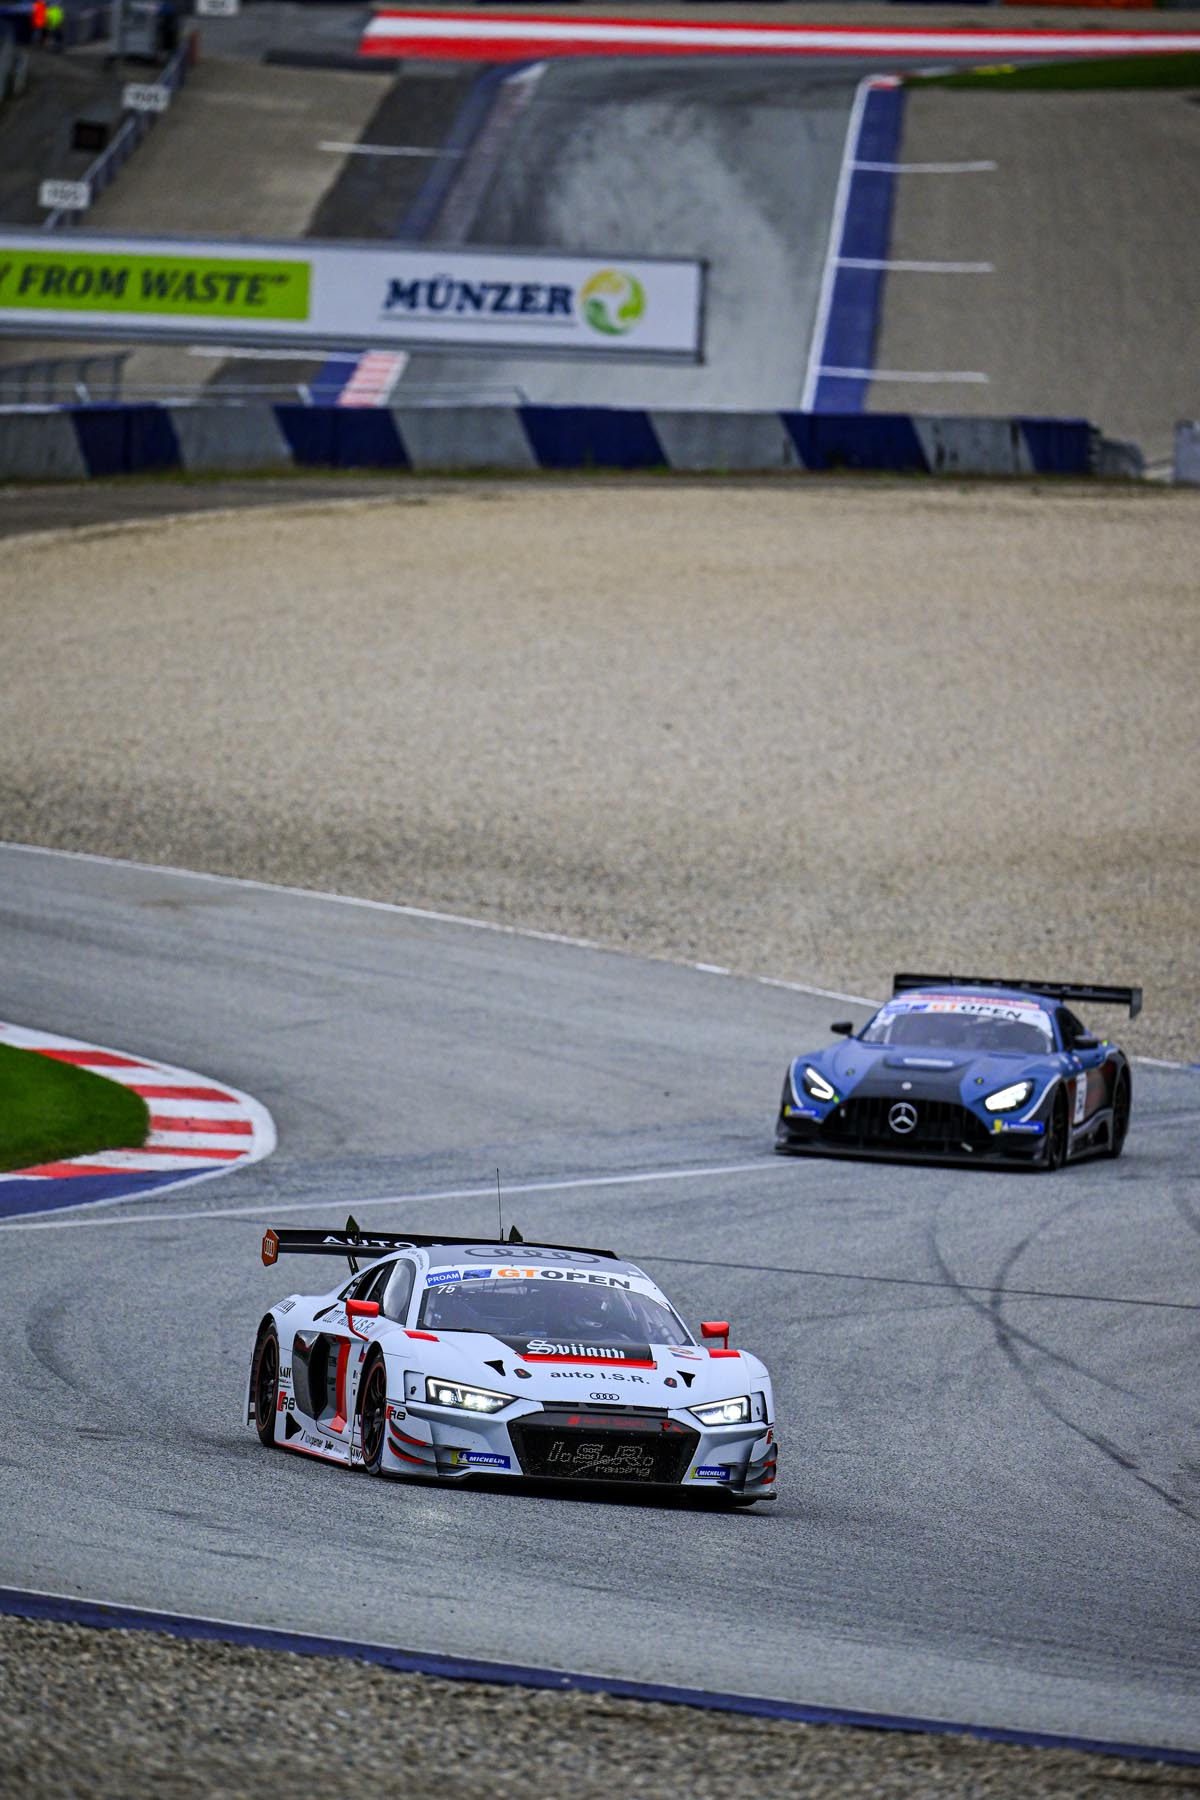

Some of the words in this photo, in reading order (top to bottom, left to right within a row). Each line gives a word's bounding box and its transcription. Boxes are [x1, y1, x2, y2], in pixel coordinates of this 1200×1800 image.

[18, 262, 130, 299] FROM
[384, 273, 573, 315] MÜNZER
[427, 1272, 460, 1286] PROAM
[437, 1285, 457, 1295] 75
[550, 1372, 594, 1380] auto
[600, 1372, 650, 1385] I.S.R.
[389, 1409, 407, 1421] R8
[469, 1456, 505, 1465] MICHELIN
